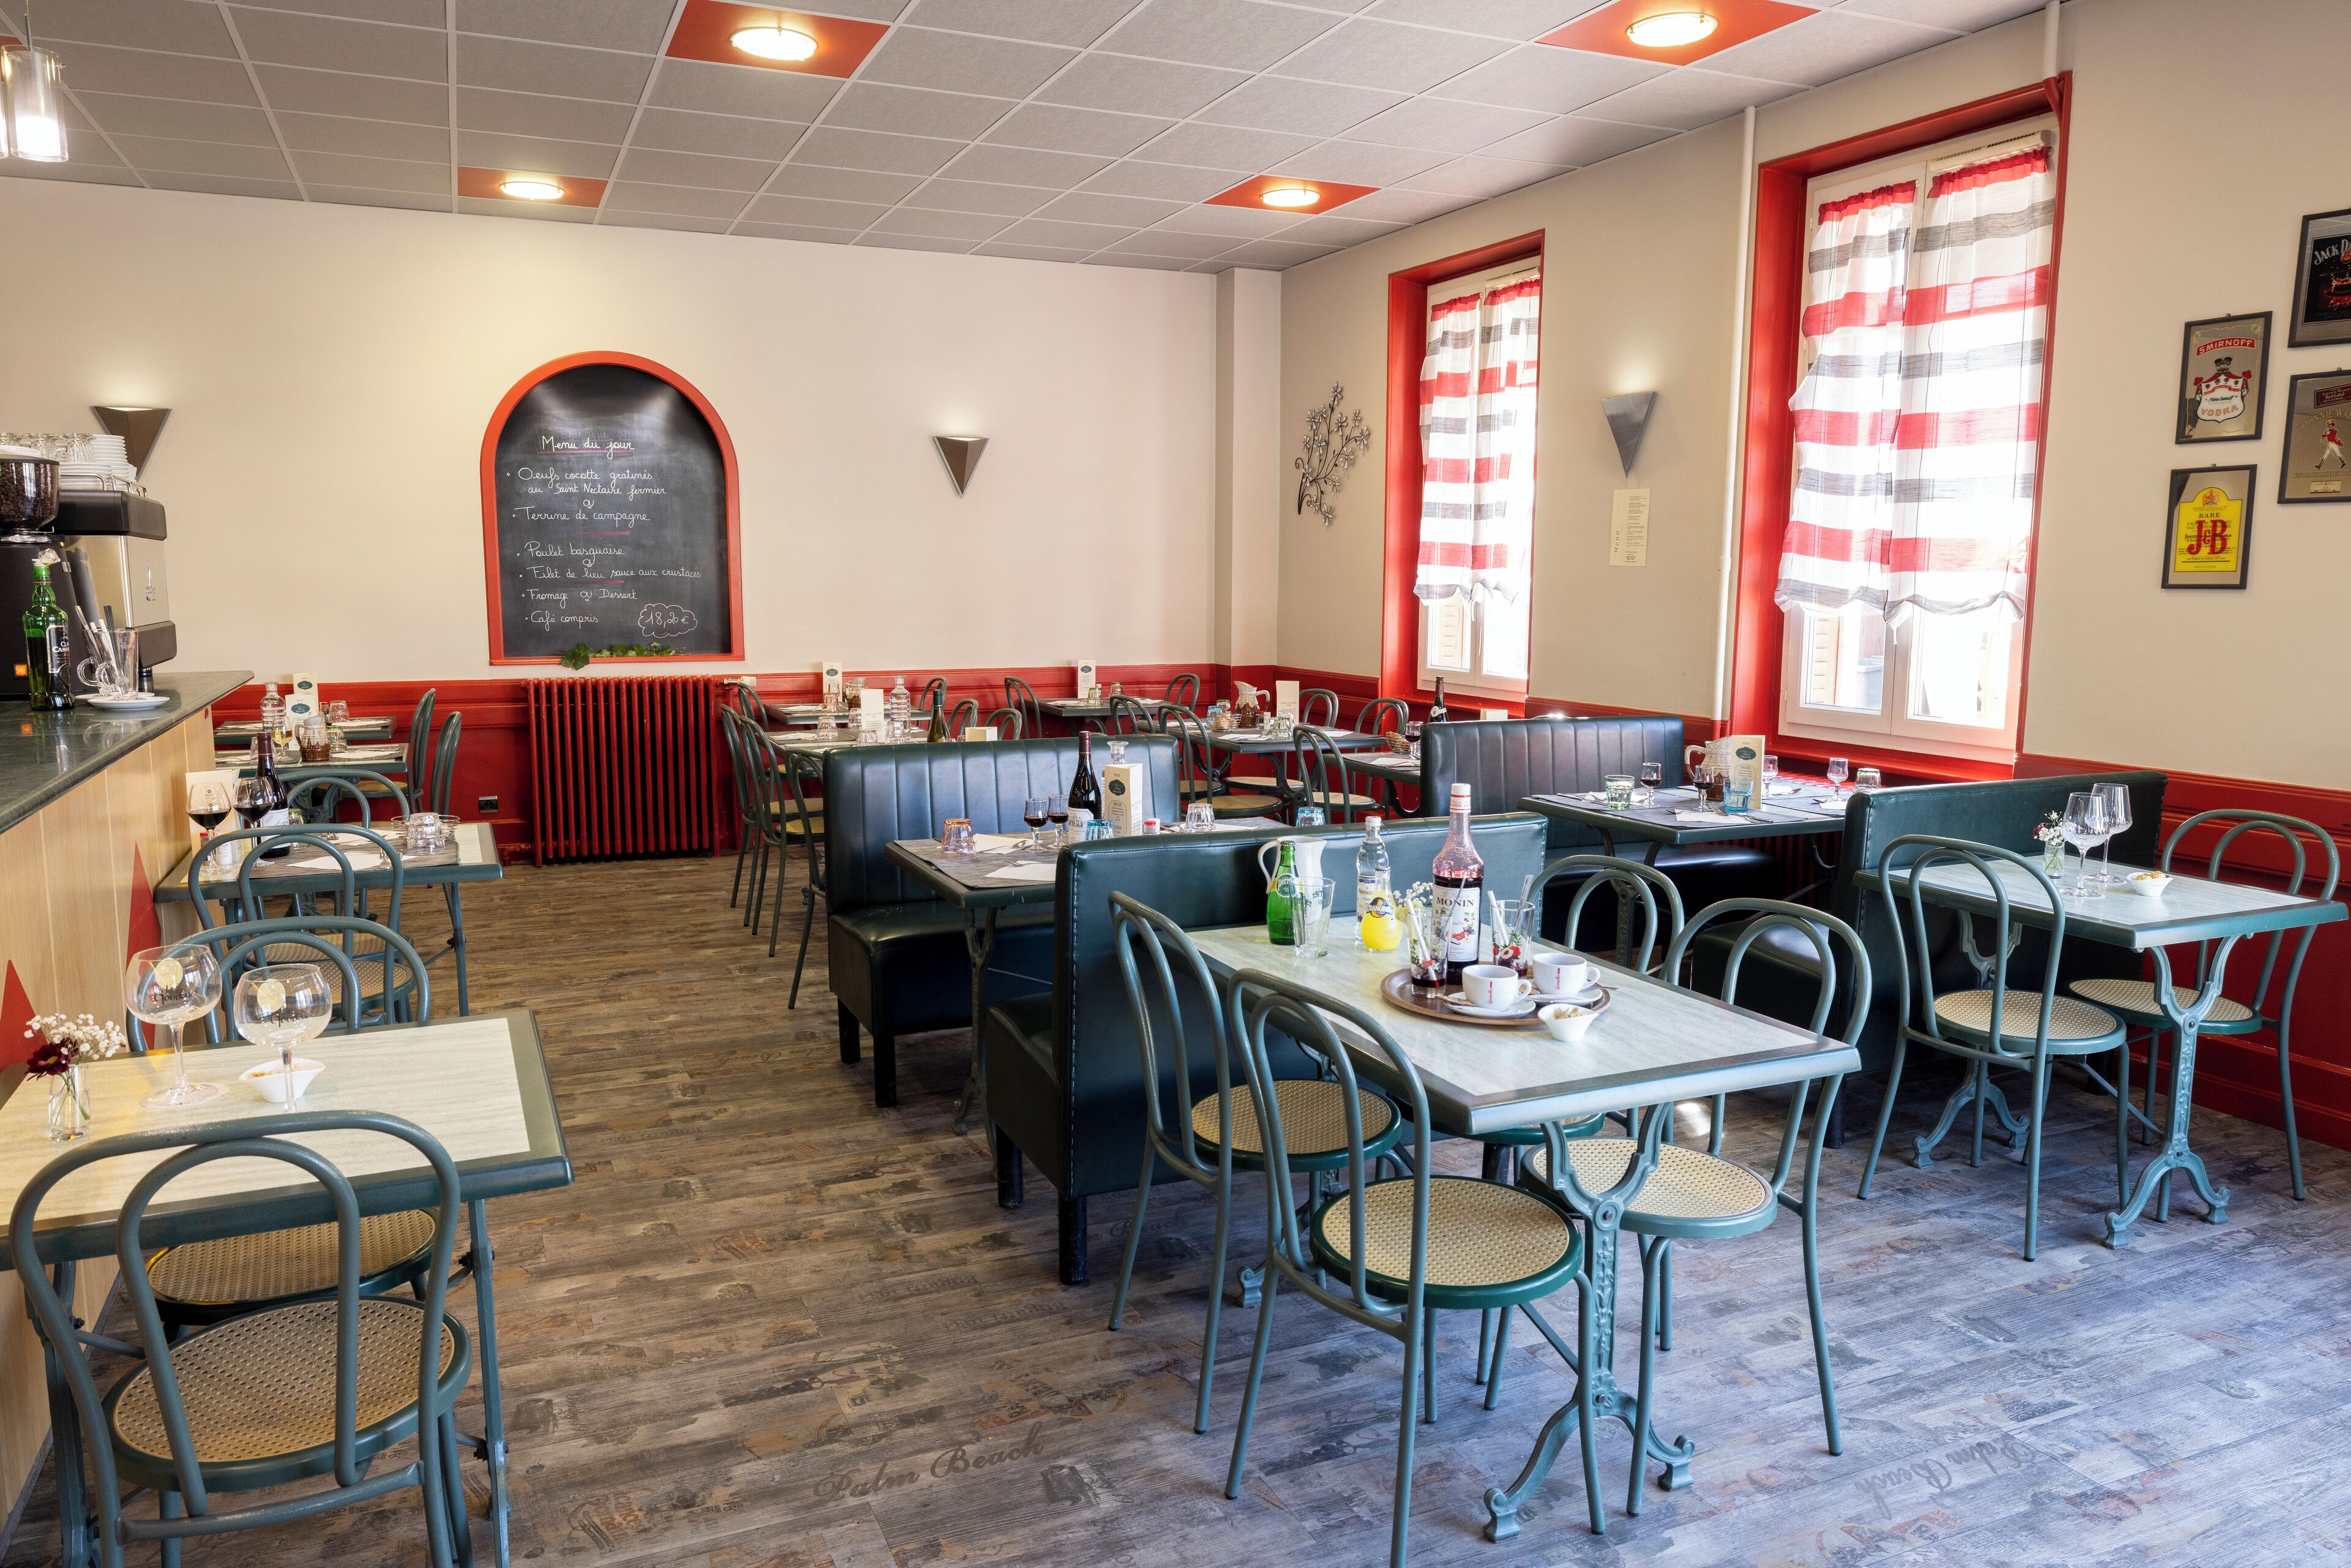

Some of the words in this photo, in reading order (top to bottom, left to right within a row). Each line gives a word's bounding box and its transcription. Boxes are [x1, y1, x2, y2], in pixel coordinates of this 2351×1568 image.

[2314, 244, 2339, 264] JACK
[2199, 339, 2253, 354] SMIRNOFF
[2201, 405, 2239, 416] VODKA
[2298, 410, 2333, 433] JOHNNIE
[542, 435, 579, 452] Menu
[584, 438, 600, 449] du
[607, 439, 635, 459] jour
[518, 467, 559, 488] Oeufs
[565, 470, 601, 479] cocotte
[610, 469, 653, 489] gratinés
[553, 483, 579, 494] Saint
[583, 483, 622, 494] Nectaire
[627, 485, 666, 501] fermier
[514, 506, 569, 520] Terrine
[576, 509, 588, 520] de
[593, 512, 651, 528] campagne
[525, 541, 563, 557] Poulet
[570, 543, 624, 561] basquaise
[527, 566, 561, 579] Filet
[566, 568, 577, 578] de
[582, 568, 605, 579] lieu
[610, 569, 635, 578] sauce
[662, 568, 700, 578] crustacés
[527, 589, 568, 609] Fromage
[599, 588, 637, 600] Dessert
[531, 610, 555, 631] Café
[561, 614, 598, 628] compris
[1436, 897, 1474, 907] MONIN
[813, 1462, 920, 1502] Palm
[930, 1421, 1044, 1478] Beach
[1855, 1458, 1952, 1520] Beach
